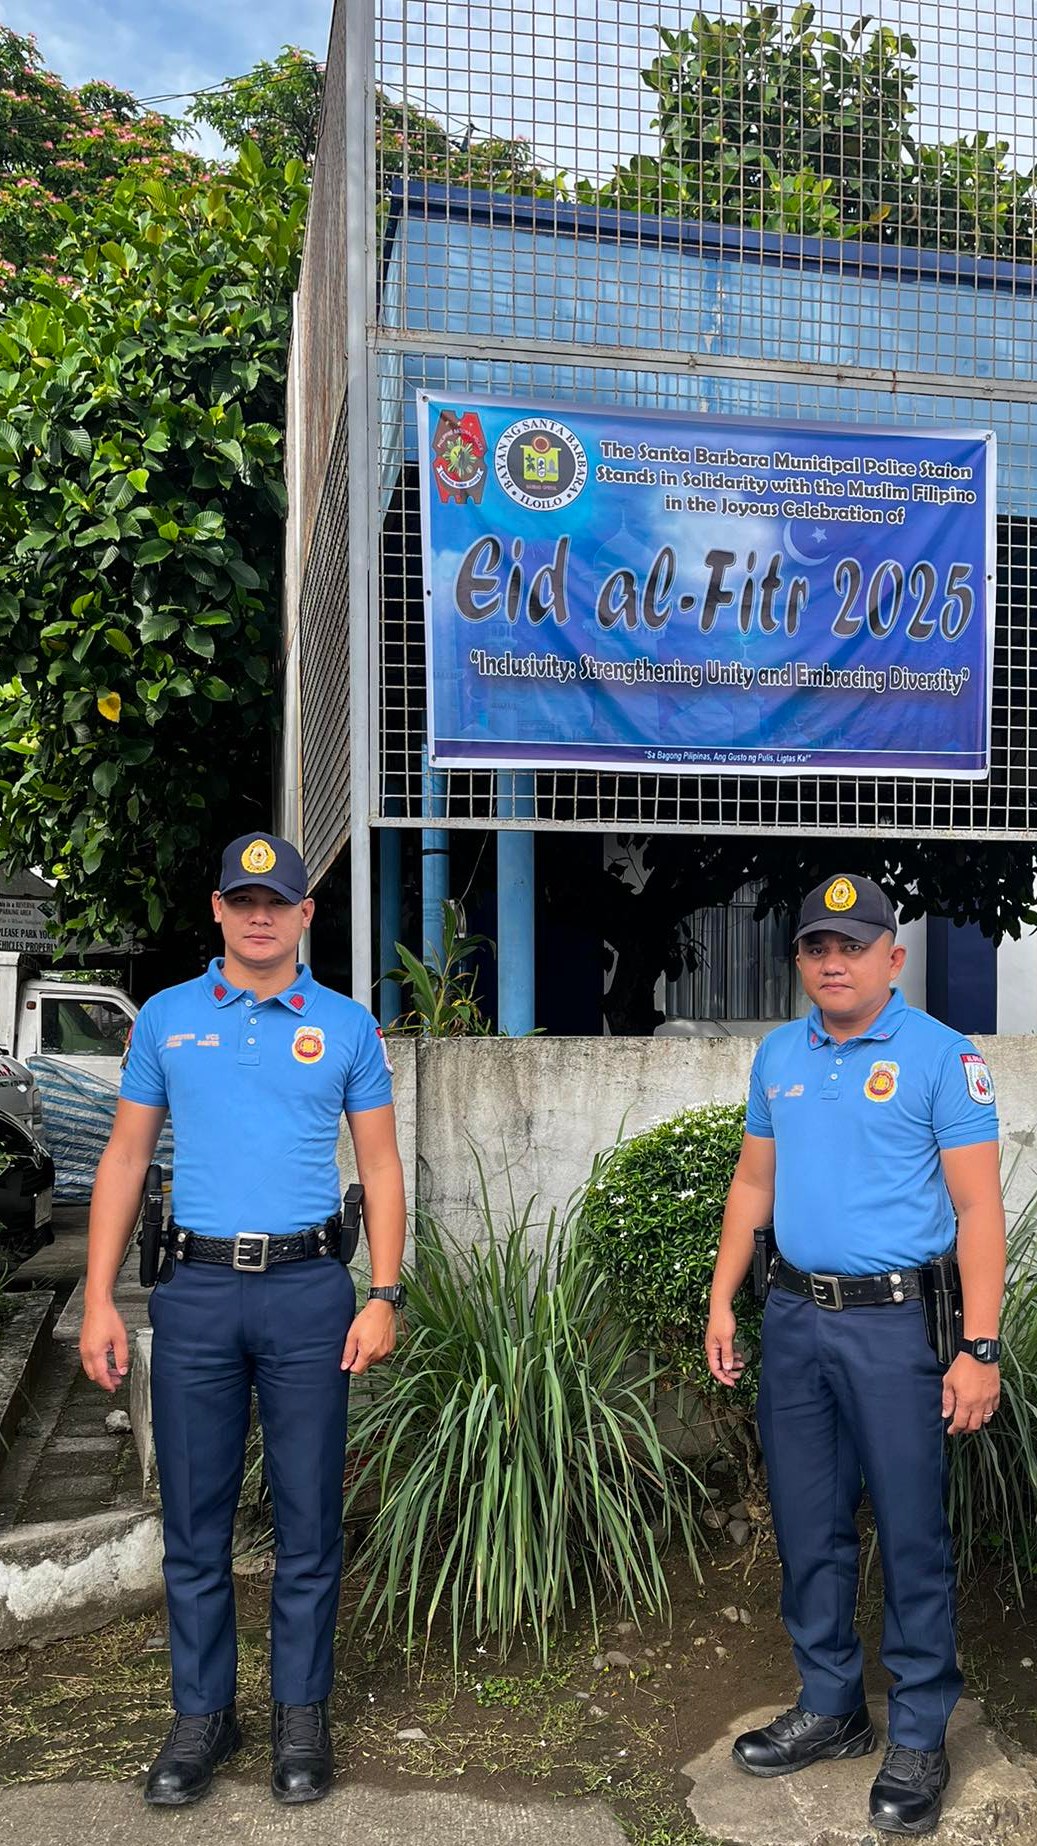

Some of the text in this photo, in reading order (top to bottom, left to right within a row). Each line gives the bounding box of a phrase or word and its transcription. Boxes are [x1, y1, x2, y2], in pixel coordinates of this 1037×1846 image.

[504, 426, 521, 442] NG
[523, 419, 564, 436] SANTA
[497, 443, 514, 490] BAYAN
[565, 434, 587, 493] BARBARA
[600, 440, 972, 479] The Santa Barbara Municipal Police Staion
[596, 465, 976, 506] Stands in Solidarity with the Muslim Filipino
[520, 495, 562, 508] ILOILO
[665, 494, 905, 525] in the Joyous Celebration of
[455, 533, 975, 643] Eid al-Fitr 2025
[470, 649, 970, 696] “Inclusivity: Strengthening Unity and Embracing Diversity”
[657, 751, 682, 762] Bagong
[683, 751, 712, 762] Pilipinas,
[713, 752, 727, 763] Ang
[727, 752, 747, 762] Gusto
[748, 754, 757, 764] ng
[757, 752, 775, 763] Pulis,
[776, 753, 796, 764] Ligtas
[0, 941, 24, 951] EHICLES
[20, 929, 38, 939] PARK
[38, 930, 56, 940] YOU
